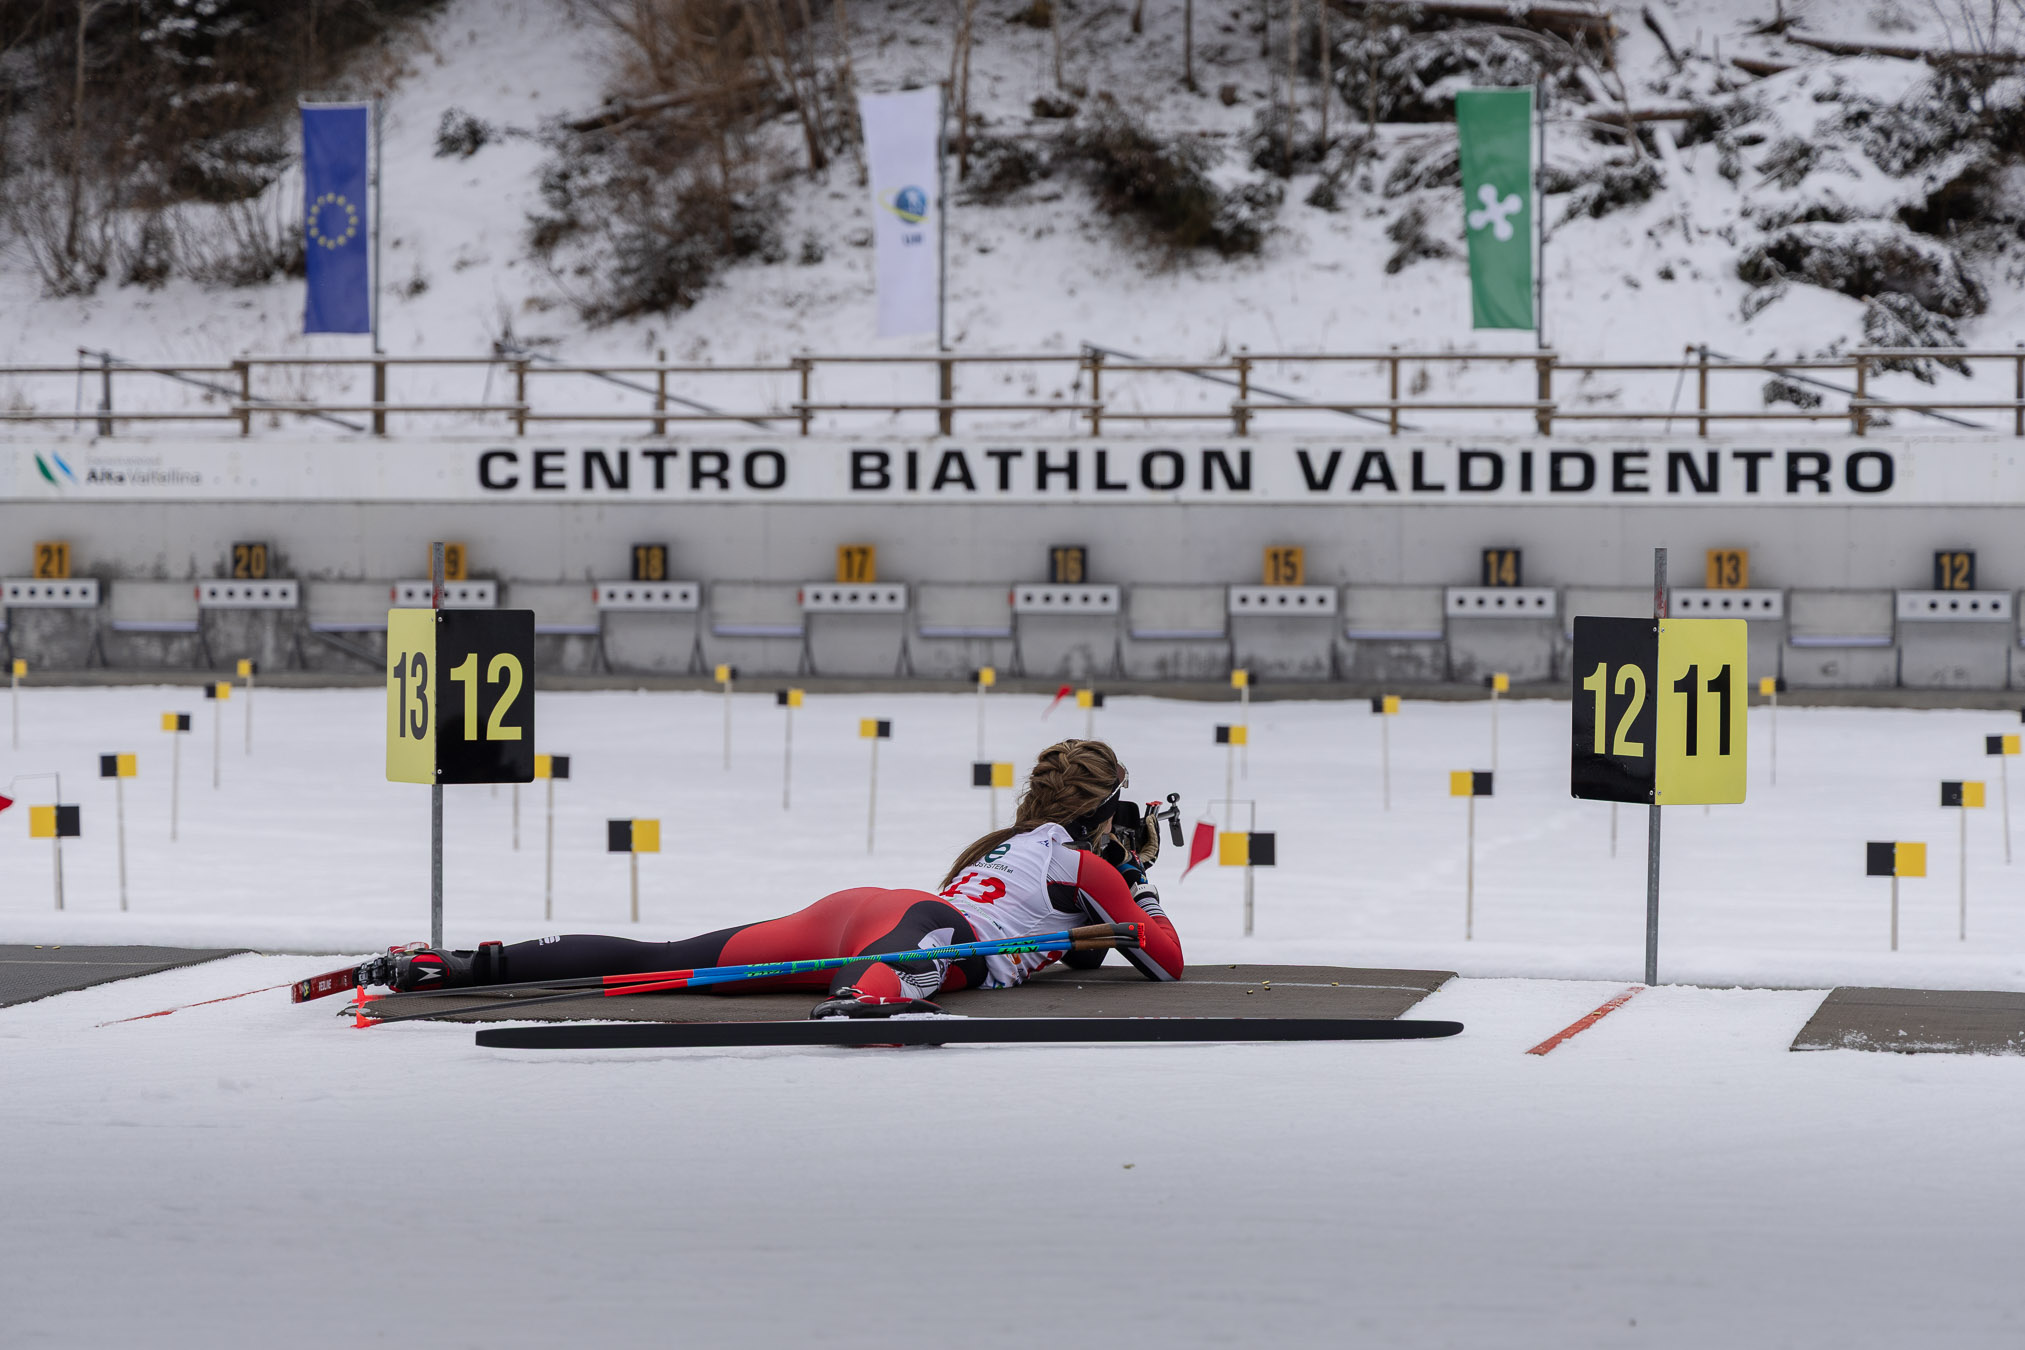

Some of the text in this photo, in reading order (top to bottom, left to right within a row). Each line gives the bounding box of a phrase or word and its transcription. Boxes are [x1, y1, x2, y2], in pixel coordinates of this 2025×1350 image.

[479, 449, 1894, 493] CENTRO BIATHLON VALDIDENTRO
[40, 547, 66, 576] 21
[235, 546, 264, 577] 20
[636, 547, 663, 578] 18
[845, 549, 870, 578] 17
[1055, 550, 1082, 583] 16
[1272, 550, 1296, 584] 15
[1487, 550, 1514, 584] 14
[1714, 551, 1740, 585] 13
[1939, 552, 1970, 586] 12
[393, 652, 429, 741] 13
[450, 652, 522, 741] 12
[1583, 663, 1645, 757] 12
[1673, 664, 1731, 757] 11
